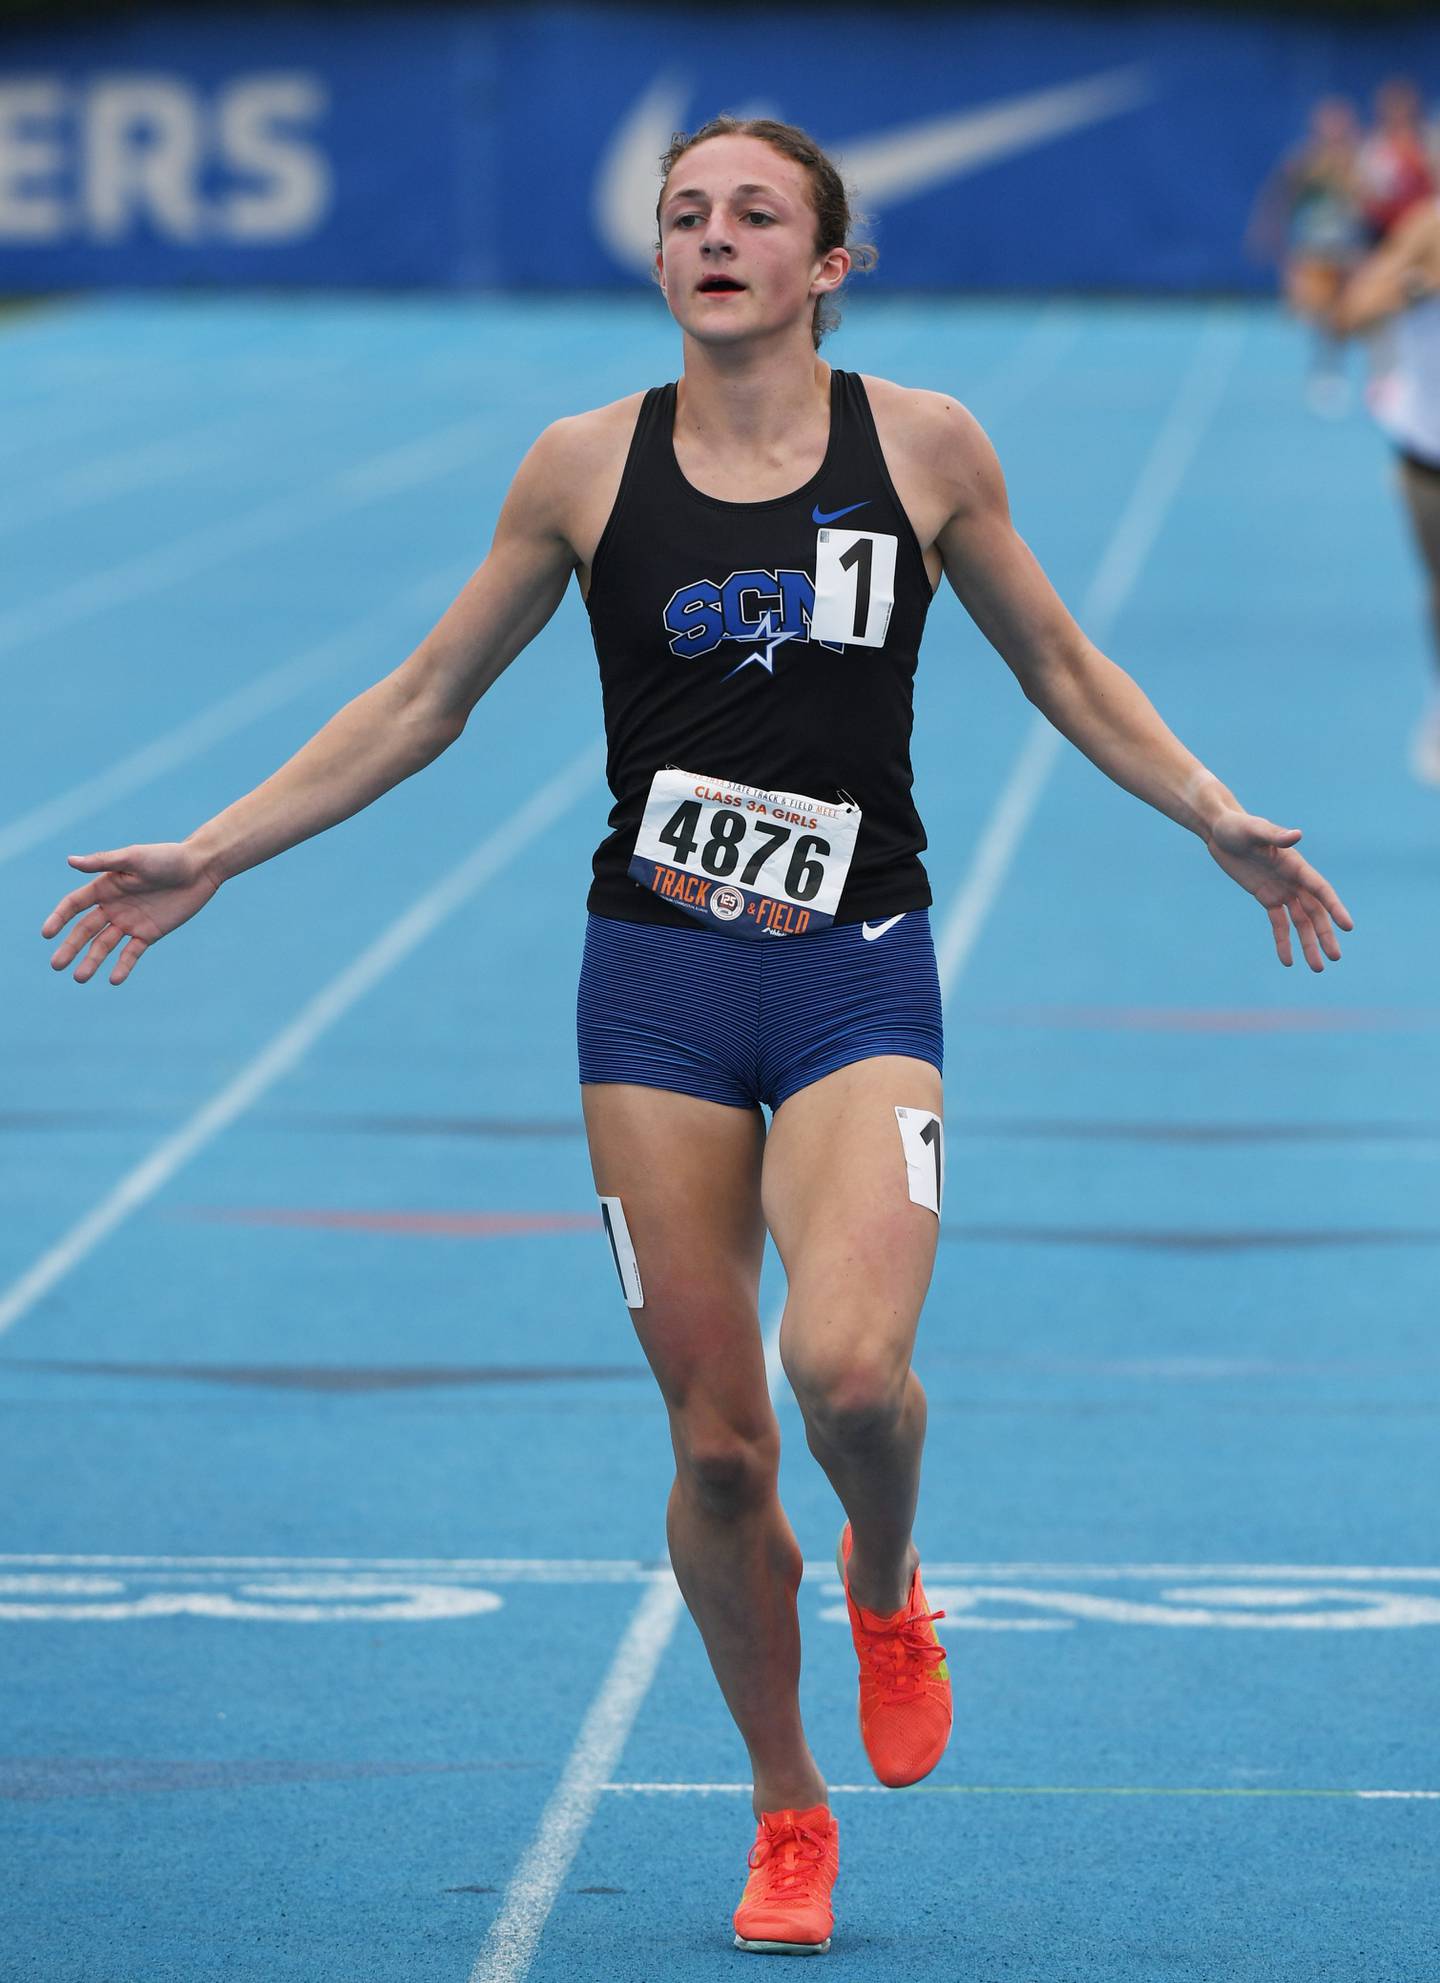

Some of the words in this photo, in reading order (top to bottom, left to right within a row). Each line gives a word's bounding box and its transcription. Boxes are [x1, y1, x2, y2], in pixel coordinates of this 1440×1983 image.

[0, 80, 330, 238] ERS
[839, 538, 873, 638] 1
[694, 785, 742, 807] CLASS
[746, 800, 767, 815] 3A
[772, 808, 818, 830] GIRLS
[727, 782, 750, 794] STATE
[753, 788, 779, 802] TRACK
[789, 799, 813, 812] FIELD
[815, 805, 837, 817] MEET
[658, 800, 831, 902] 4876
[652, 865, 712, 907] TRACK
[747, 902, 755, 915] &
[755, 898, 810, 934] FIELD
[720, 893, 736, 907] 125
[920, 1118, 941, 1213] 1
